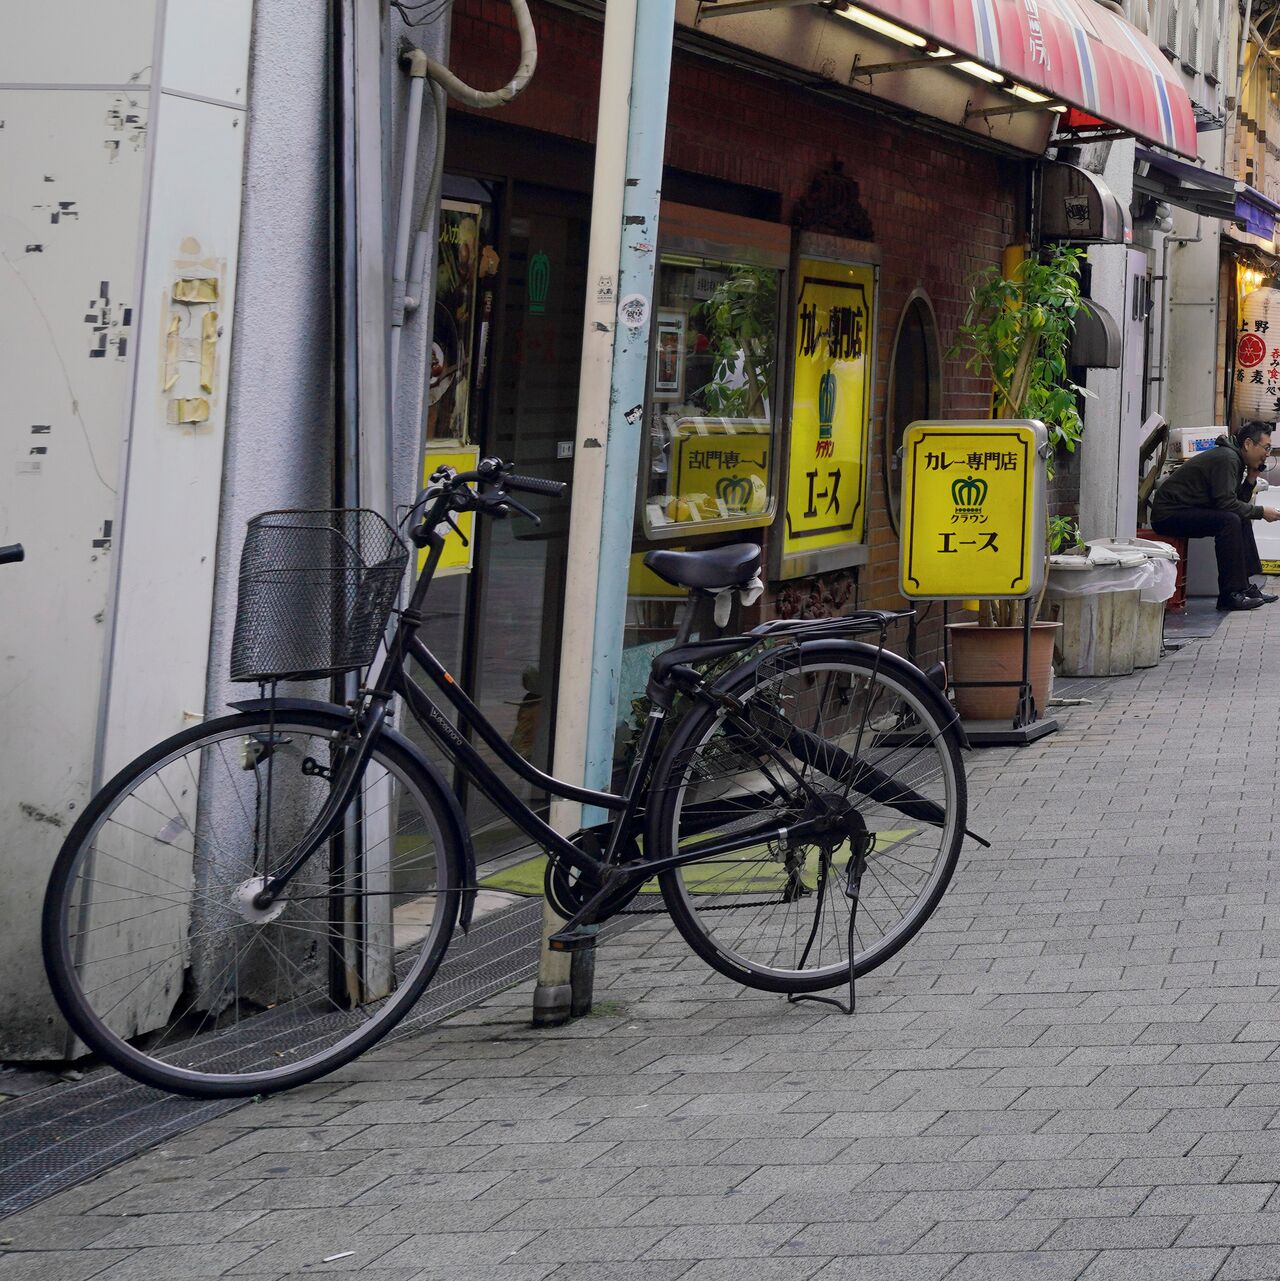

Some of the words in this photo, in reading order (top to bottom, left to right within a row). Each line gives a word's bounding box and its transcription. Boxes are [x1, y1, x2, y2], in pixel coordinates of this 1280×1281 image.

[798, 303, 864, 360] カレー専門店
[1238, 319, 1270, 334] 上野
[815, 440, 835, 459] クラウン
[923, 450, 1019, 473] カレー専門店
[803, 467, 842, 518] エース
[950, 513, 989, 524] クラウン
[936, 531, 1000, 555] エース
